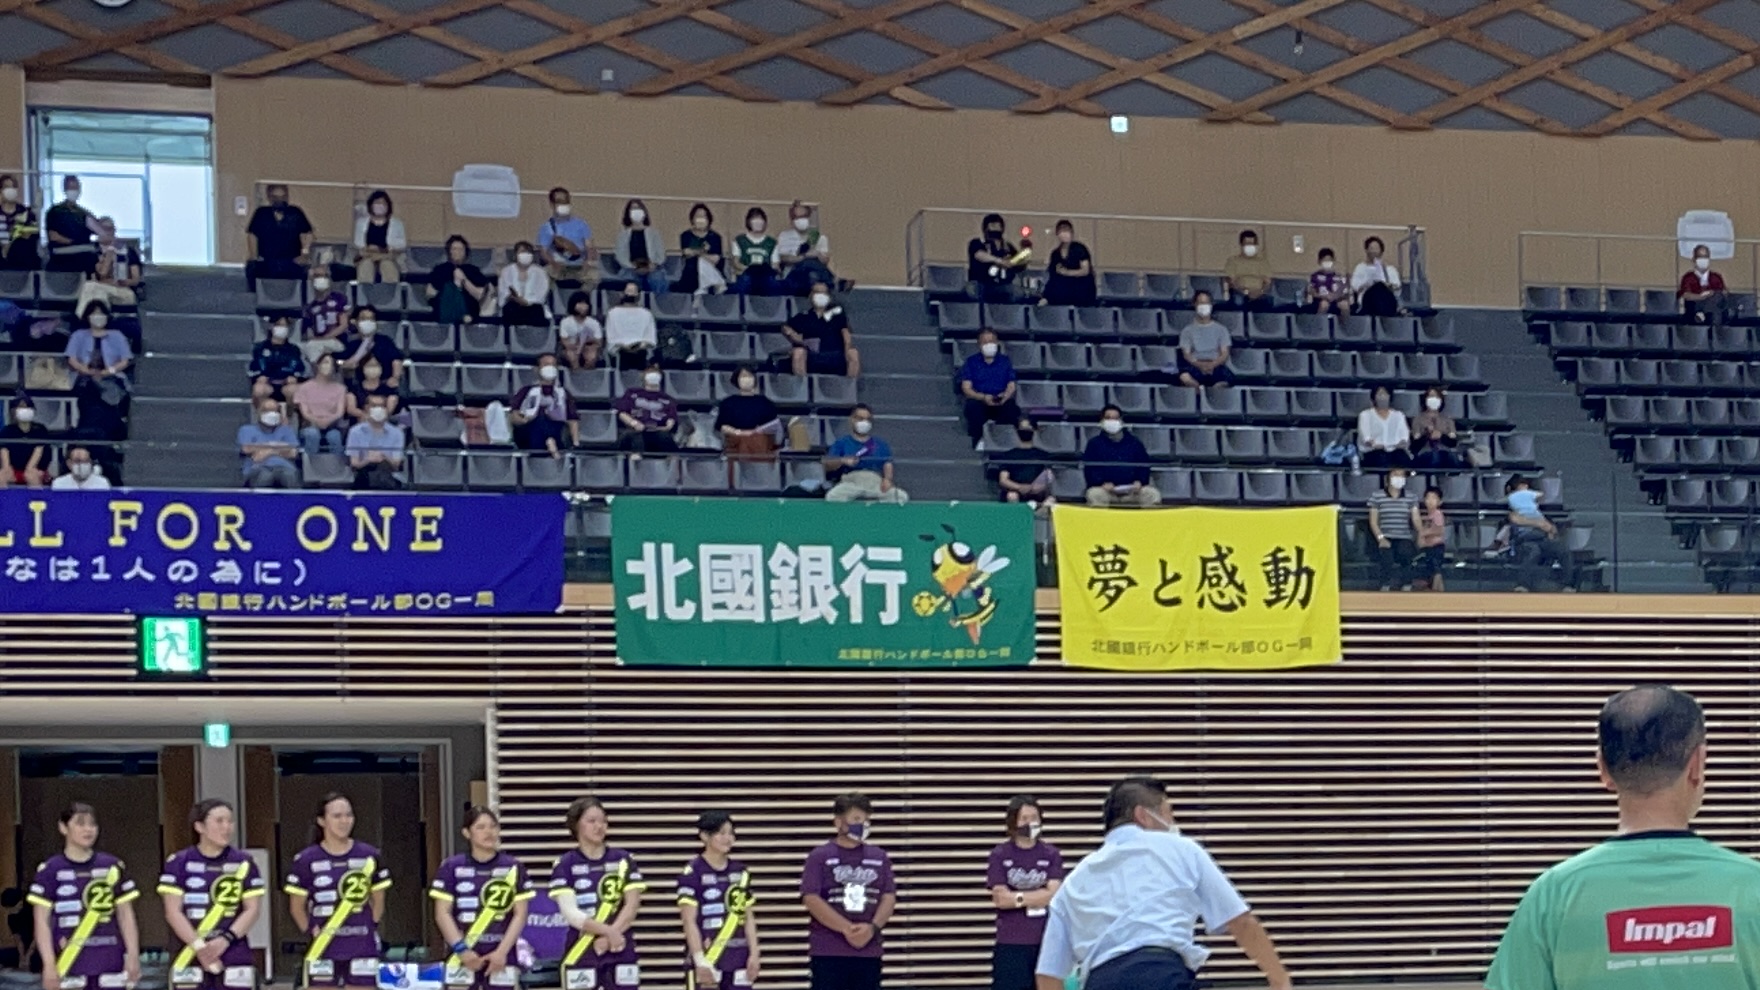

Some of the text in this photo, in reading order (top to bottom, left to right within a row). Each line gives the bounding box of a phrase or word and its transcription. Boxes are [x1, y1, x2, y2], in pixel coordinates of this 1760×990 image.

[108, 500, 253, 551] FOR
[296, 505, 444, 551] ONE
[626, 541, 907, 625] 北國銀行
[1087, 543, 1315, 613] 夢と感動
[487, 885, 511, 907] 27
